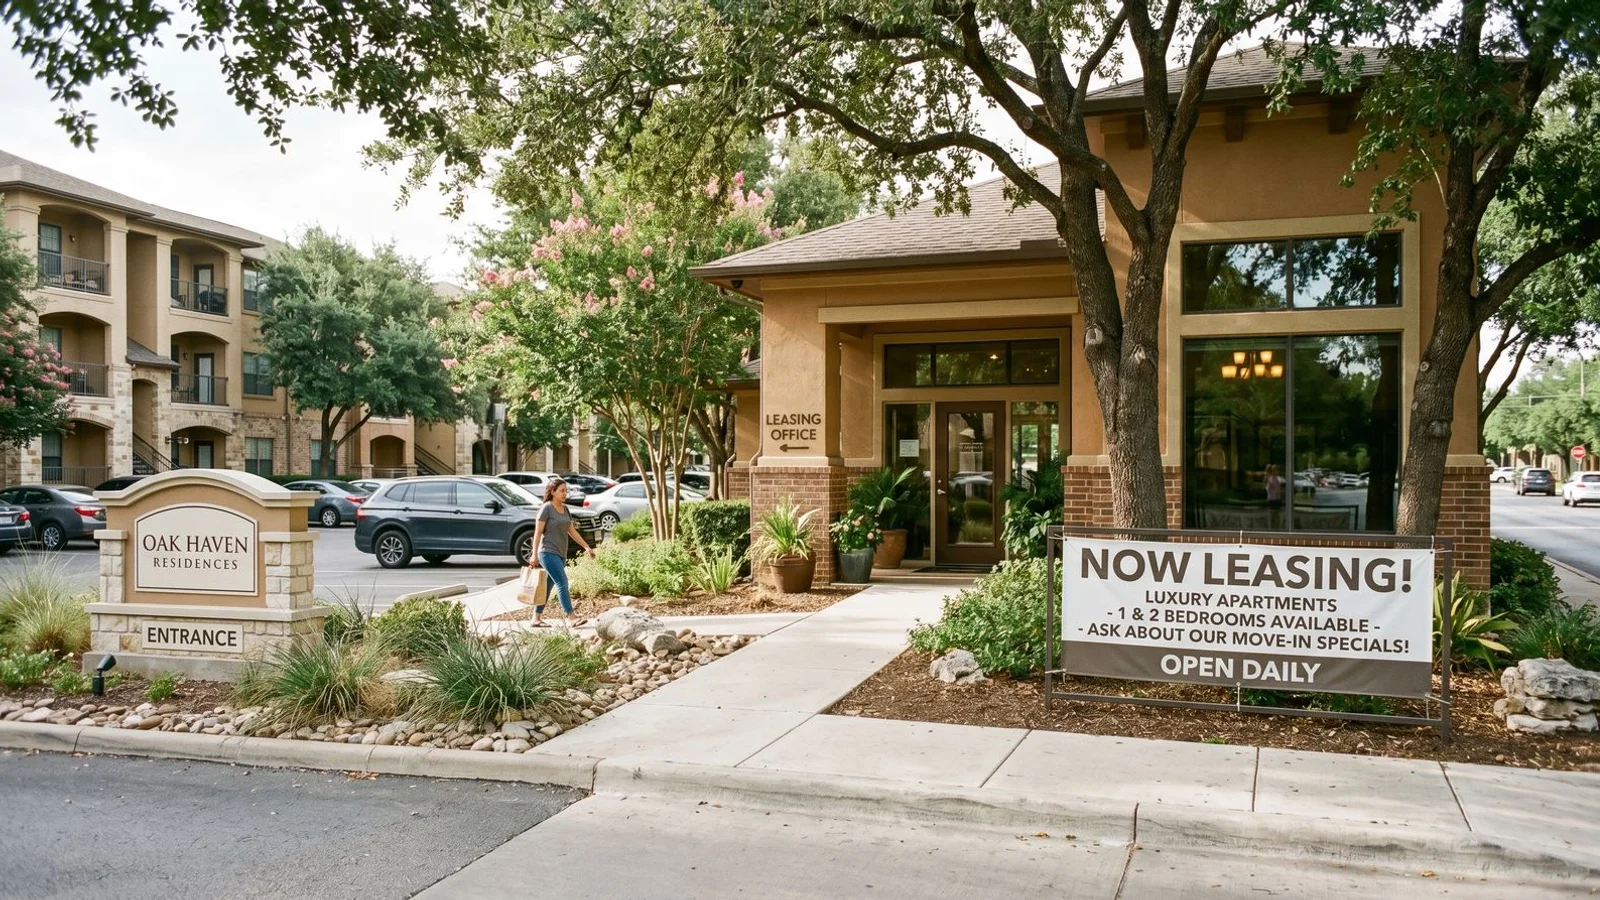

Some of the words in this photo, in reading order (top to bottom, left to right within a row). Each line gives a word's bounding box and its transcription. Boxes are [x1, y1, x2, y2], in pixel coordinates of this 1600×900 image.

[766, 413, 822, 426] LEASING
[770, 428, 817, 441] OFFICE
[142, 534, 182, 552] OAK
[186, 535, 248, 554] HAVEN
[153, 557, 238, 570] RESIDENCES
[1081, 547, 1192, 584] NOW
[1203, 552, 1412, 594] LEASING!
[1145, 590, 1214, 607] LUXURY
[1216, 593, 1338, 613] APARTMENTS
[1118, 606, 1125, 620] 1
[1131, 607, 1145, 621] &
[1149, 608, 1160, 622] 2
[1164, 609, 1266, 628] BEDROOMS
[1269, 614, 1369, 633] AVAILABLE
[147, 627, 237, 647] ENTRANCE
[1087, 622, 1121, 638] ASK
[1124, 624, 1186, 642] ABOUT
[1188, 628, 1227, 645] OUR
[1232, 631, 1312, 649] MOVE-IN
[1316, 635, 1410, 654] SPECIALS!
[1160, 654, 1234, 679] OPEN
[1242, 659, 1322, 684] DAILY
